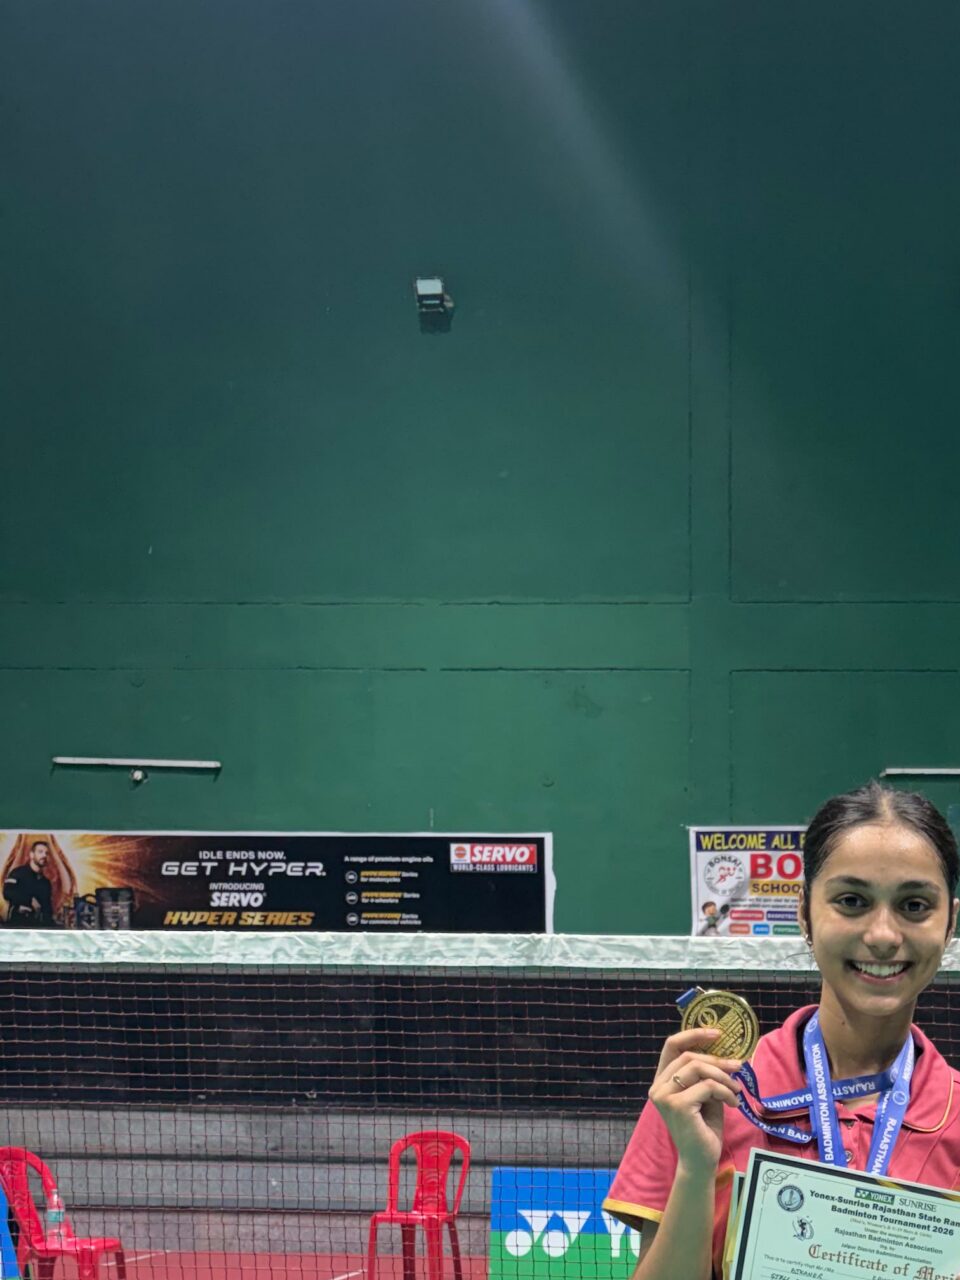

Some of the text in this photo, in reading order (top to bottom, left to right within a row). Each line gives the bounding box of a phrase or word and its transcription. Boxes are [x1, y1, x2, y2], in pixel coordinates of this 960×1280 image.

[700, 834, 795, 850] WELCOME ALL
[199, 851, 287, 860] IDLE ENDS NOW.
[471, 846, 529, 863] SERVO
[708, 855, 742, 868] BONSAI
[161, 862, 327, 876] GET HYPER.
[209, 883, 265, 891] INTRODUCING
[210, 892, 264, 907] SERVO
[163, 911, 315, 926] HYPER SERIES
[832, 1082, 876, 1096] RAJAST
[811, 1044, 834, 1161] BADMINTON ASSOCIATION
[810, 1190, 870, 1210] Yonex-Sunrise
[872, 1203, 917, 1219] Rajasthan
[918, 1212, 942, 1224] State
[870, 1193, 937, 1212] YONEX SUNRISE
[831, 1205, 877, 1221] Badminton
[880, 1215, 930, 1232] Tournament
[932, 1225, 954, 1236] 2026
[834, 1227, 867, 1240] Rajasthan
[868, 1234, 903, 1247] Badminton
[904, 1242, 943, 1255] Association
[808, 1243, 888, 1273] Certificate
[893, 1262, 910, 1277] of
